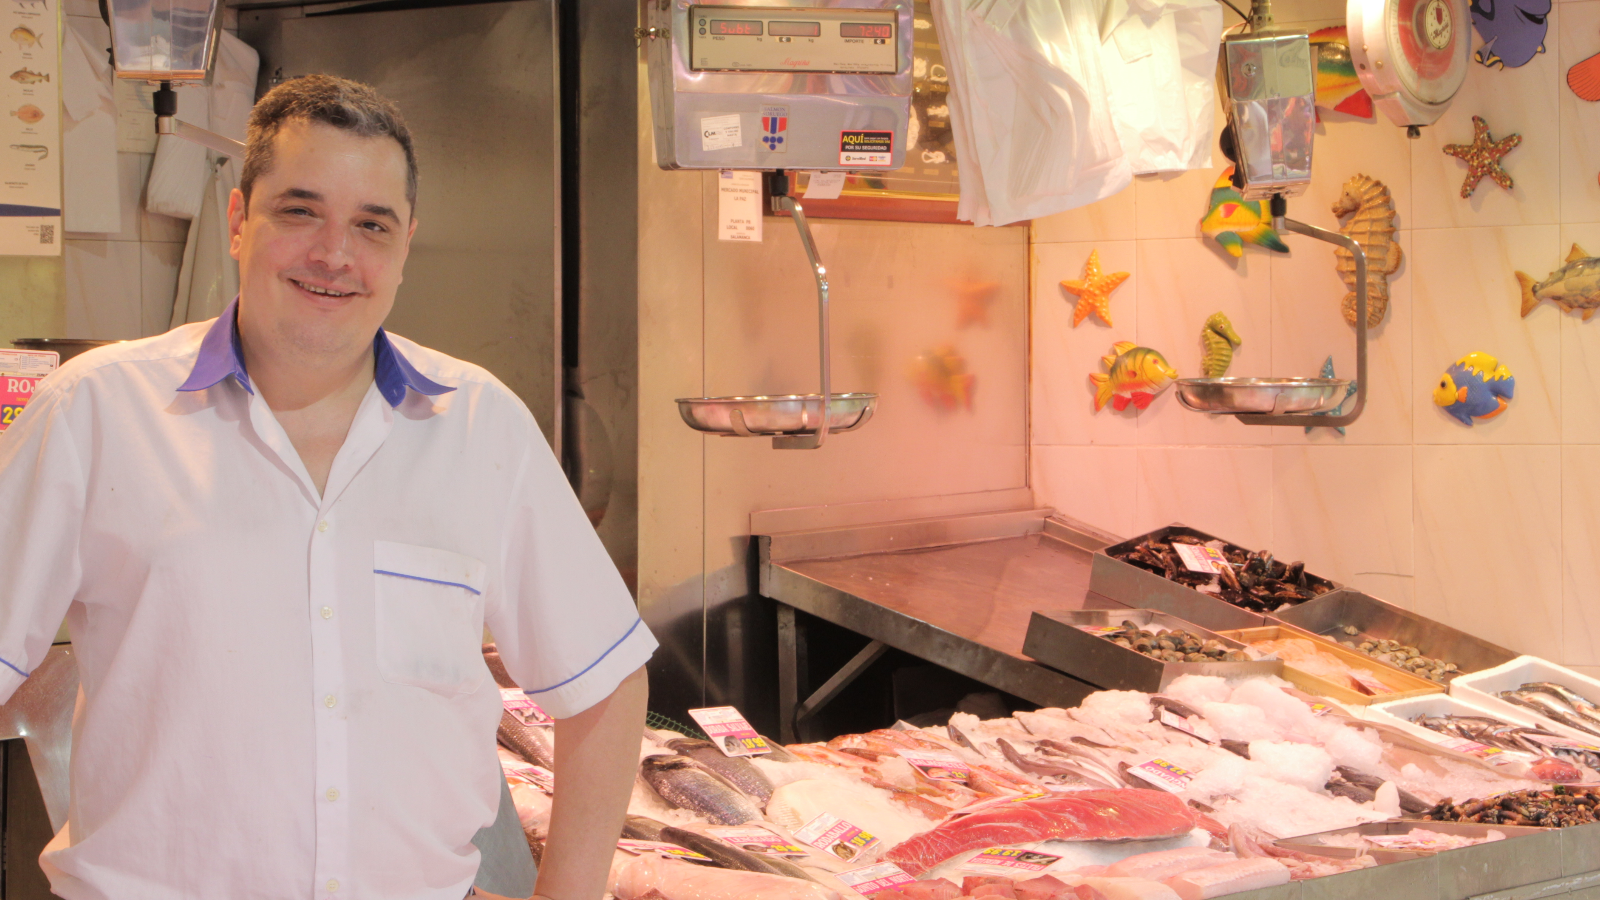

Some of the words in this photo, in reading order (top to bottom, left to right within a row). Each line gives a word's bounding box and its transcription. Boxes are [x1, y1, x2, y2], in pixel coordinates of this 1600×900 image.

[720, 22, 751, 34] Subt
[842, 133, 865, 145] AQUÍ
[812, 821, 853, 850] RODABALLO
